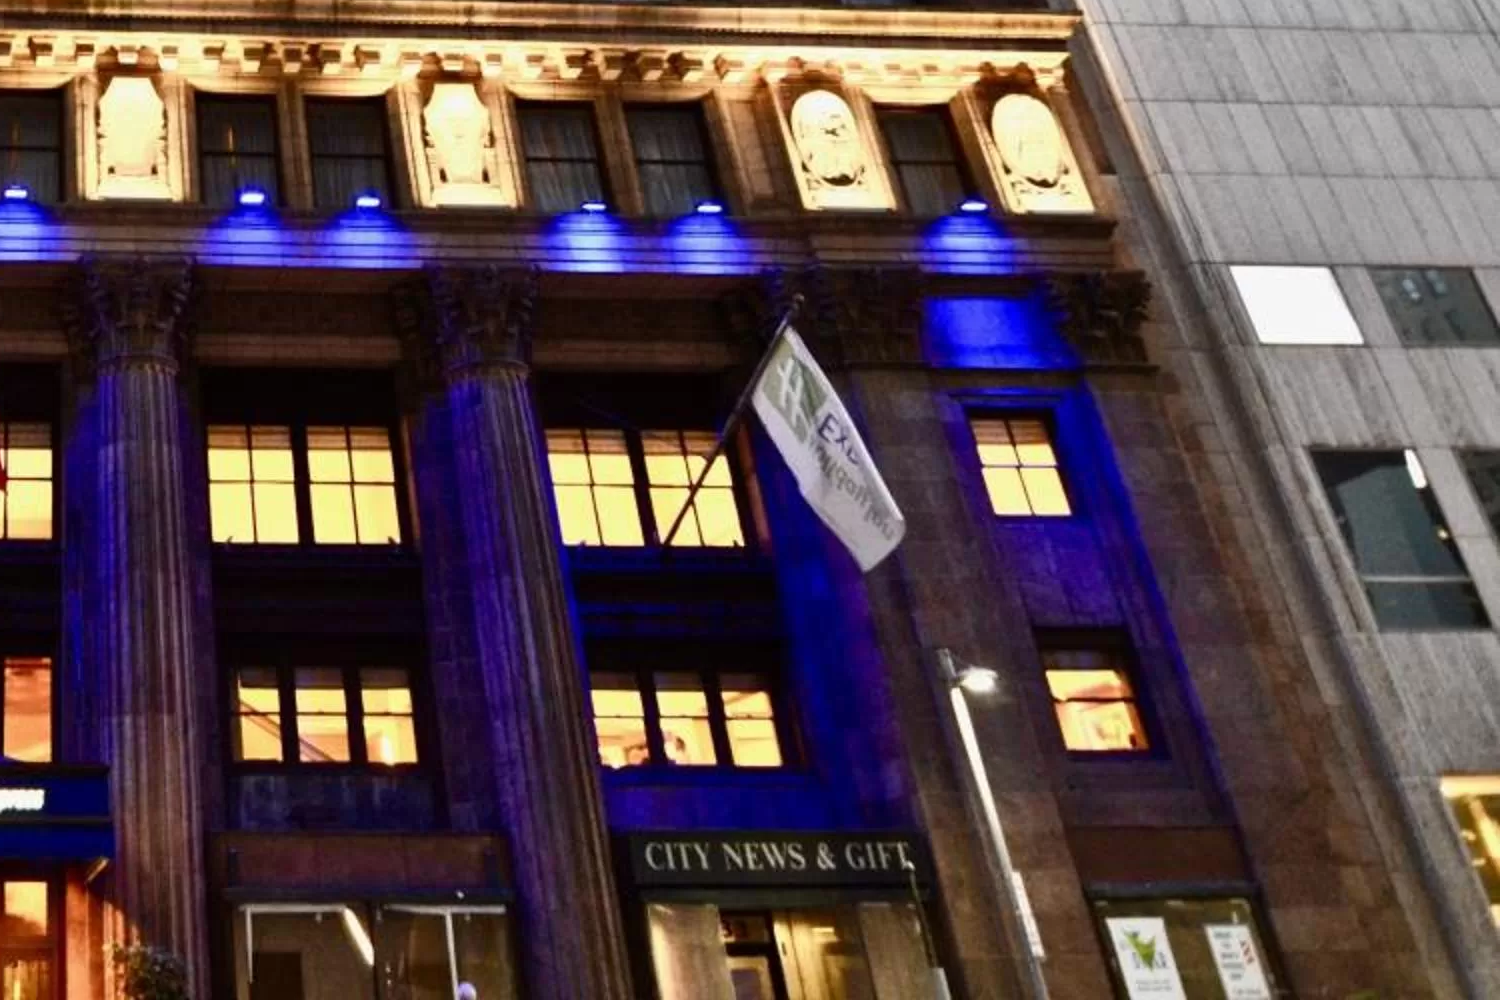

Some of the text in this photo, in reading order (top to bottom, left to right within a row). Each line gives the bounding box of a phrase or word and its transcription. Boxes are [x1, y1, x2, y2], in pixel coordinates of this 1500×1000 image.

[645, 842, 709, 870] CITY
[722, 842, 806, 871] NEWS
[816, 842, 837, 870] &
